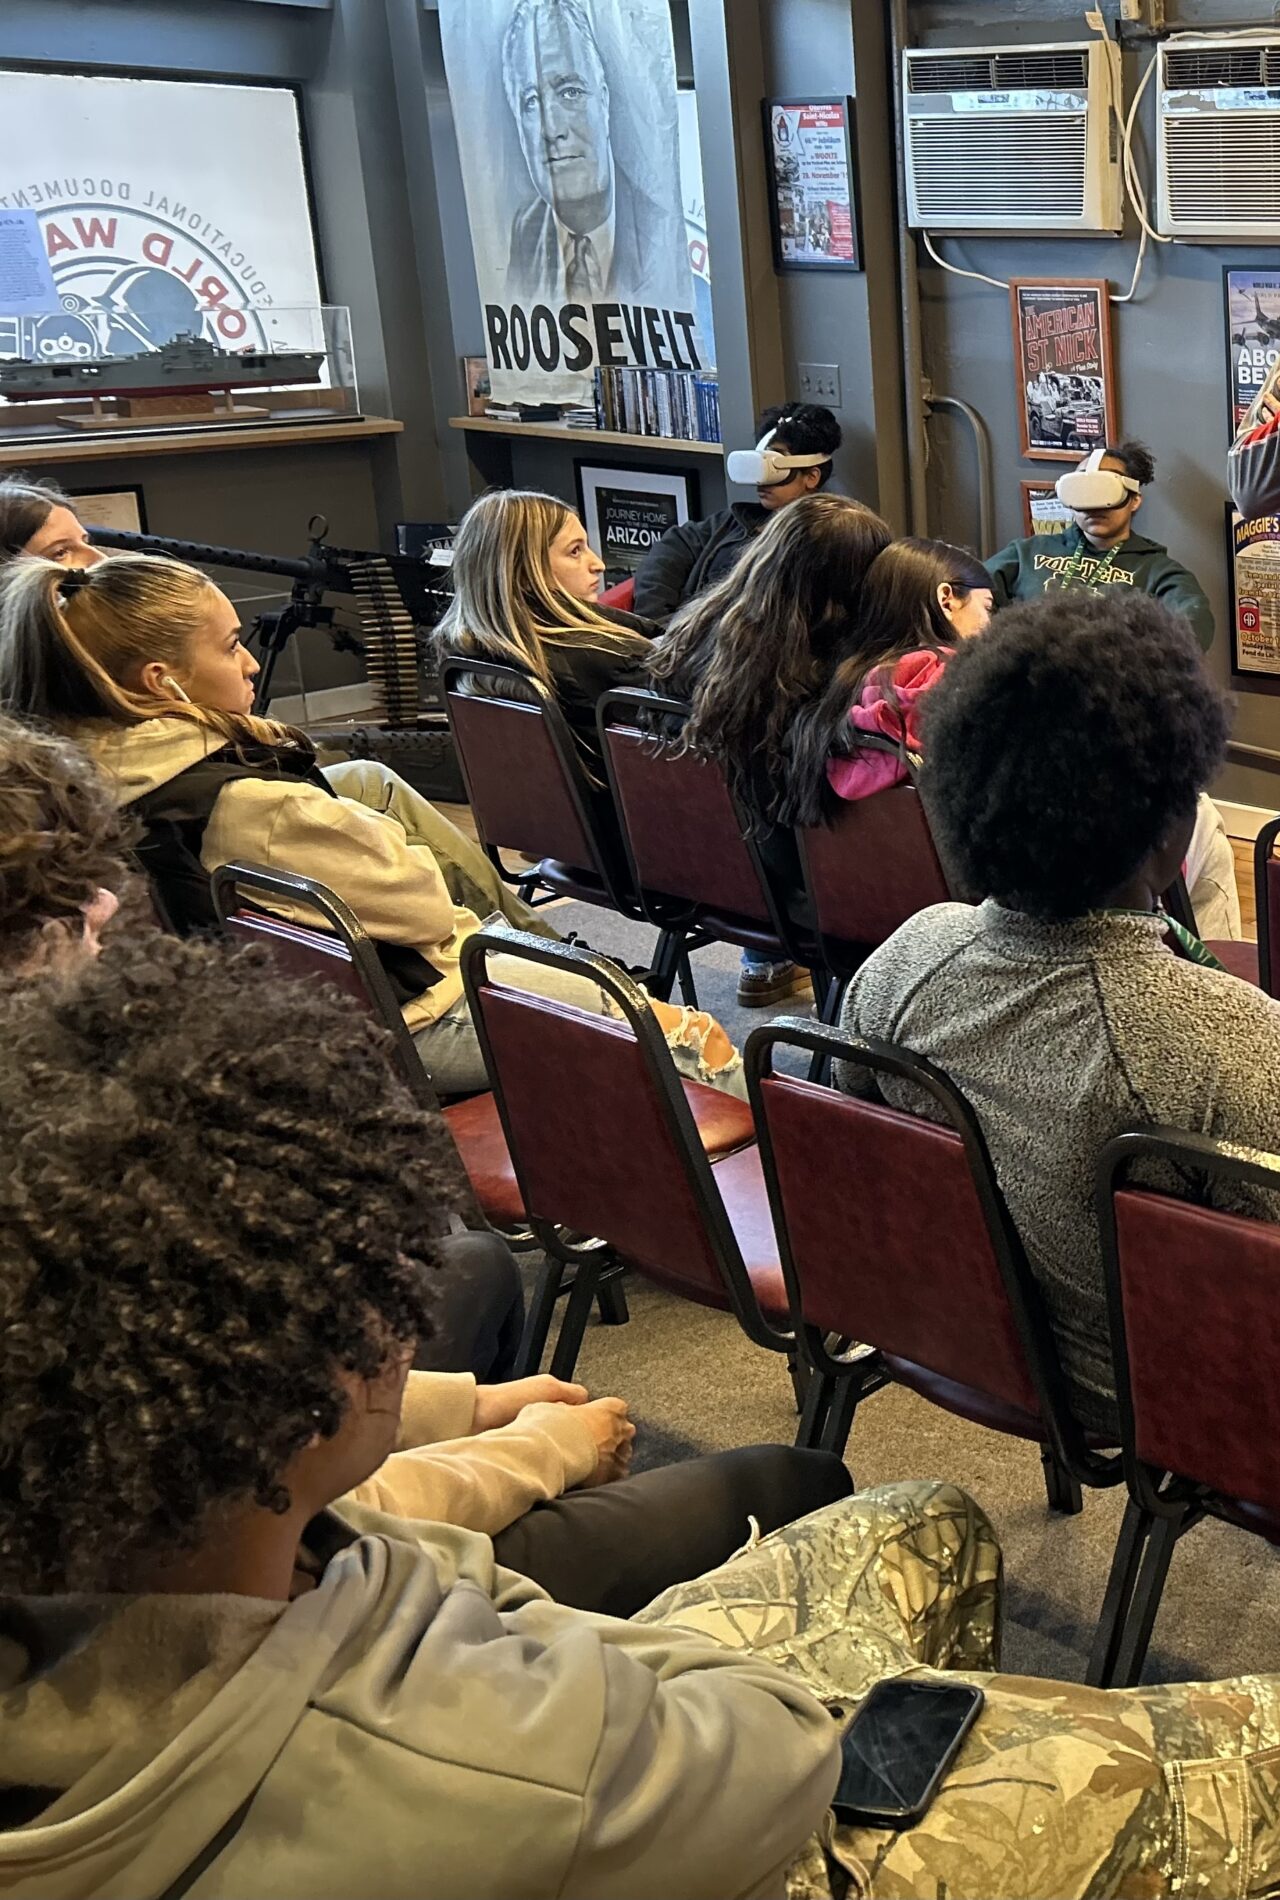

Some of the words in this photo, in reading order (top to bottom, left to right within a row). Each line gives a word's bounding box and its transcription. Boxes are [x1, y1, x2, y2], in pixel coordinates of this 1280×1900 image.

[485, 303, 701, 372] ROOSEVELT
[1025, 301, 1095, 341] AMERICAN
[1054, 328, 1099, 367] NICK
[605, 507, 642, 520] JOURNEY
[643, 511, 668, 525] HOME
[1236, 516, 1280, 545] MAGGIE'S
[1240, 632, 1274, 645] October
